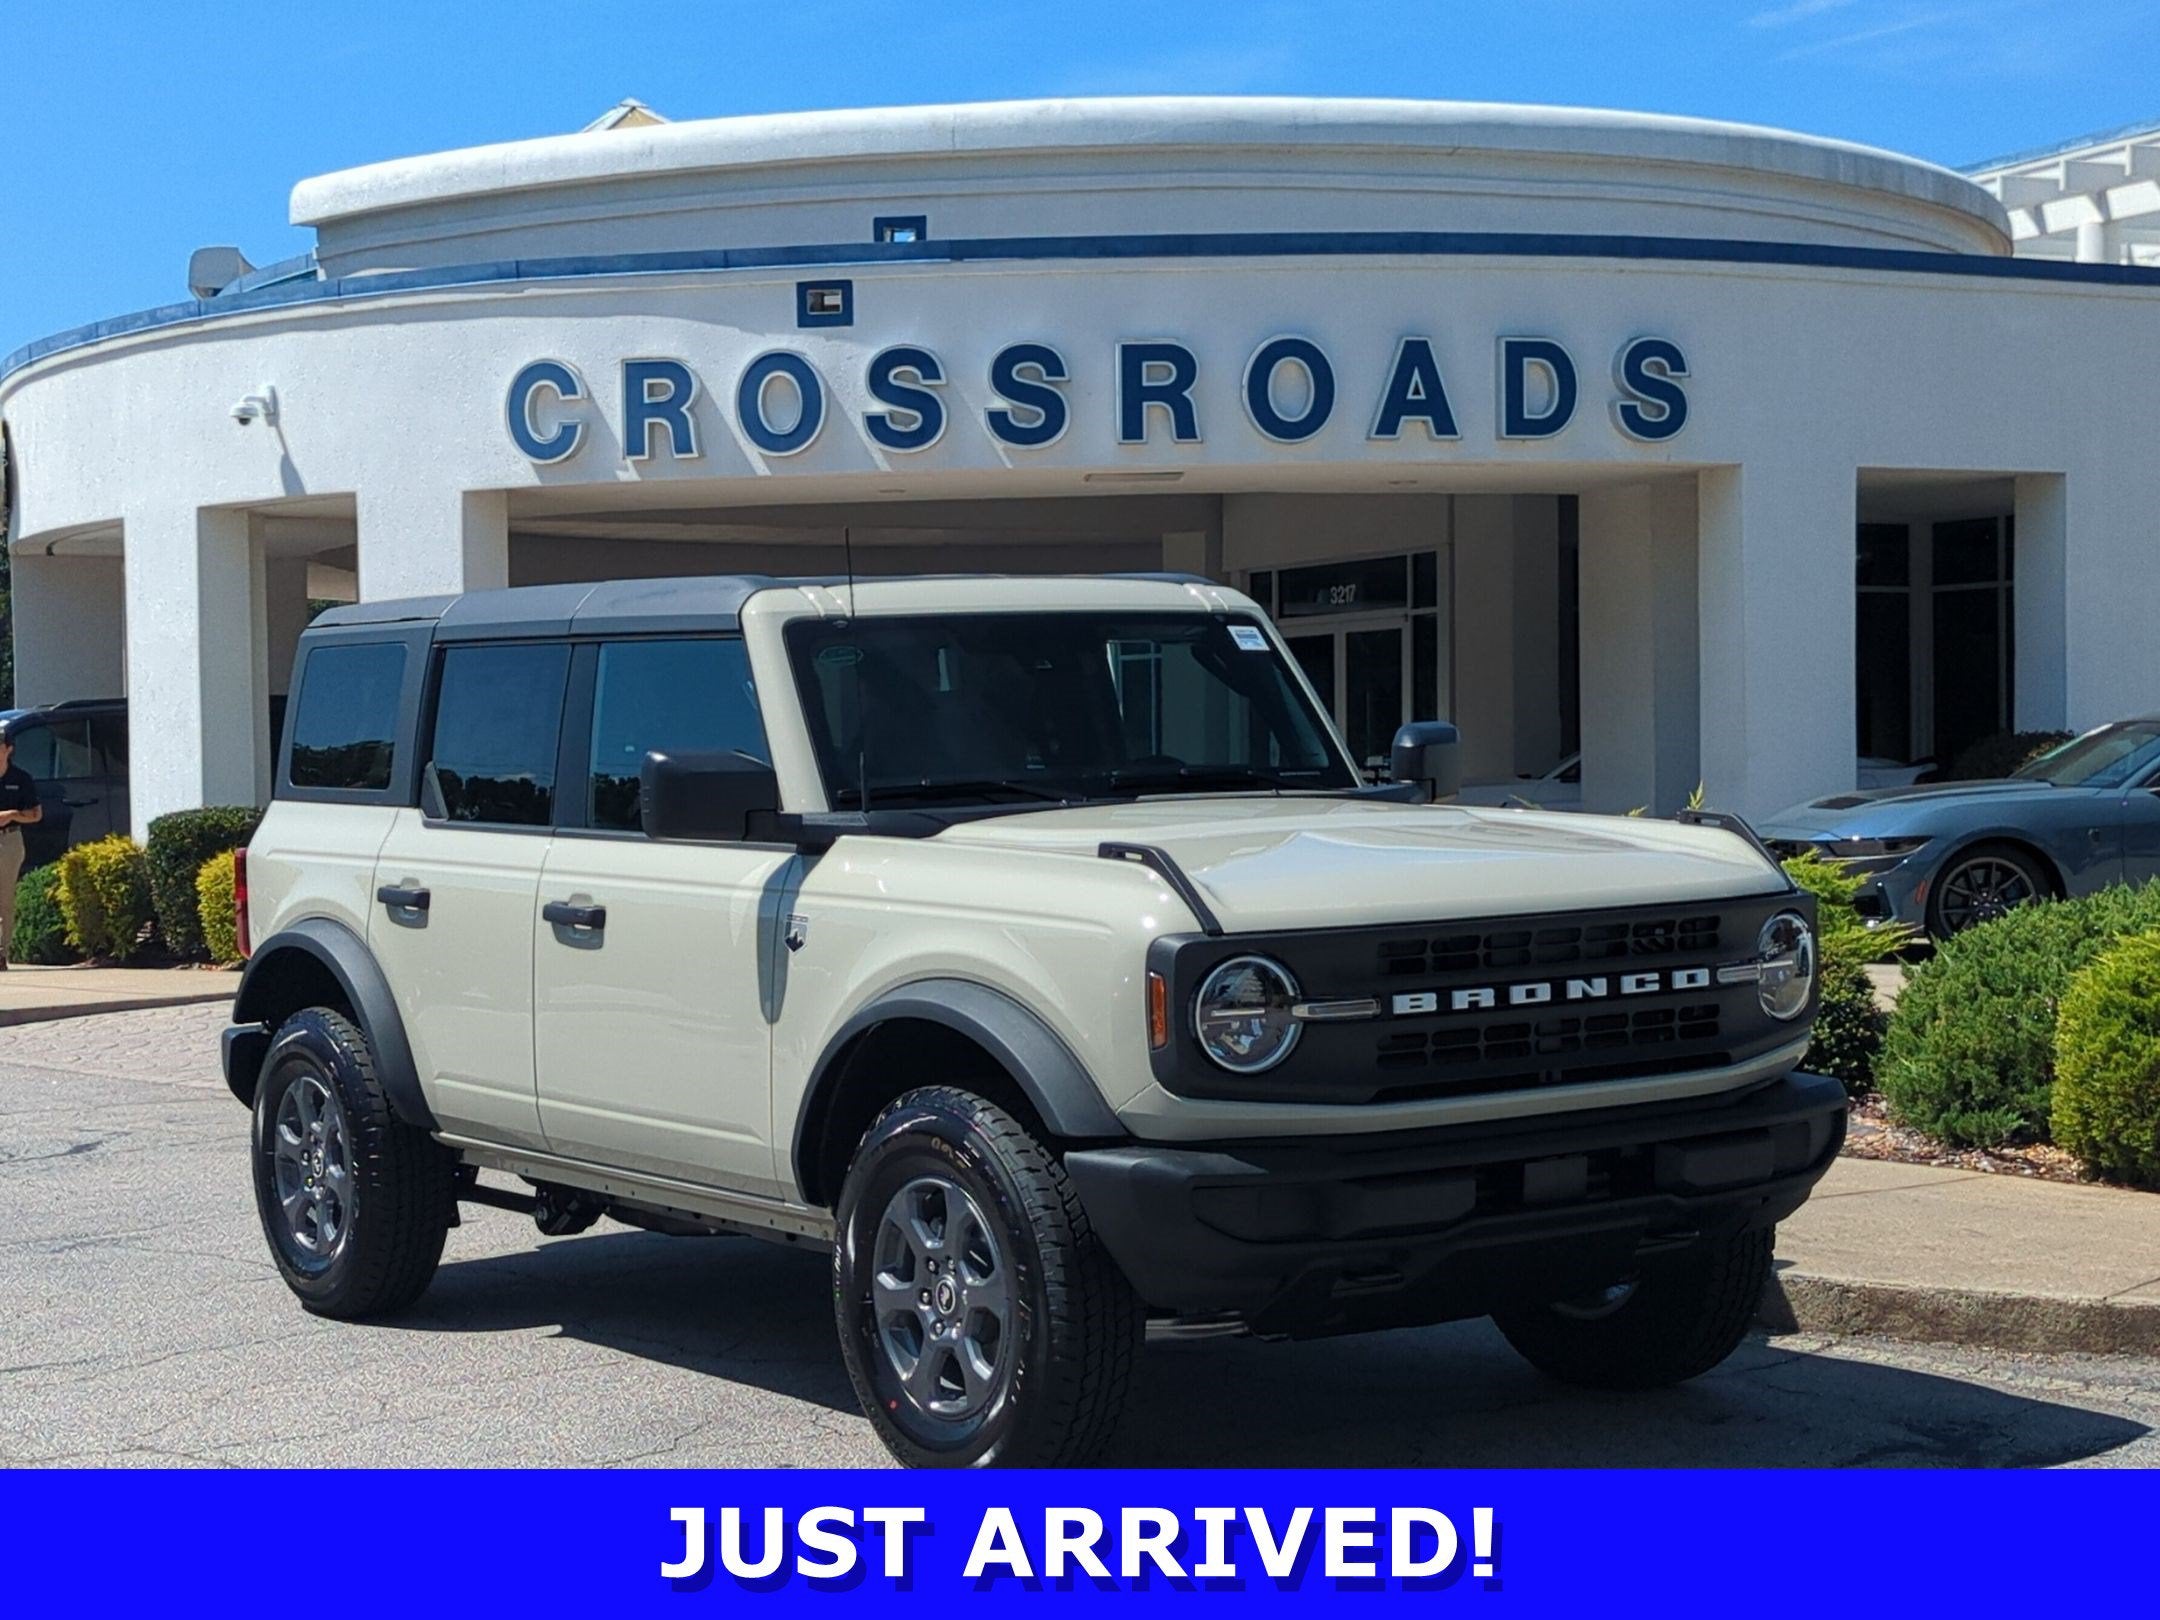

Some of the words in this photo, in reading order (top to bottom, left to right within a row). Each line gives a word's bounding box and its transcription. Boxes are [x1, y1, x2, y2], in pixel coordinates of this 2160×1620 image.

[507, 336, 1690, 465] CROSSROADS
[1329, 583, 1357, 605] 3217
[1392, 967, 1711, 1016] BRONCO
